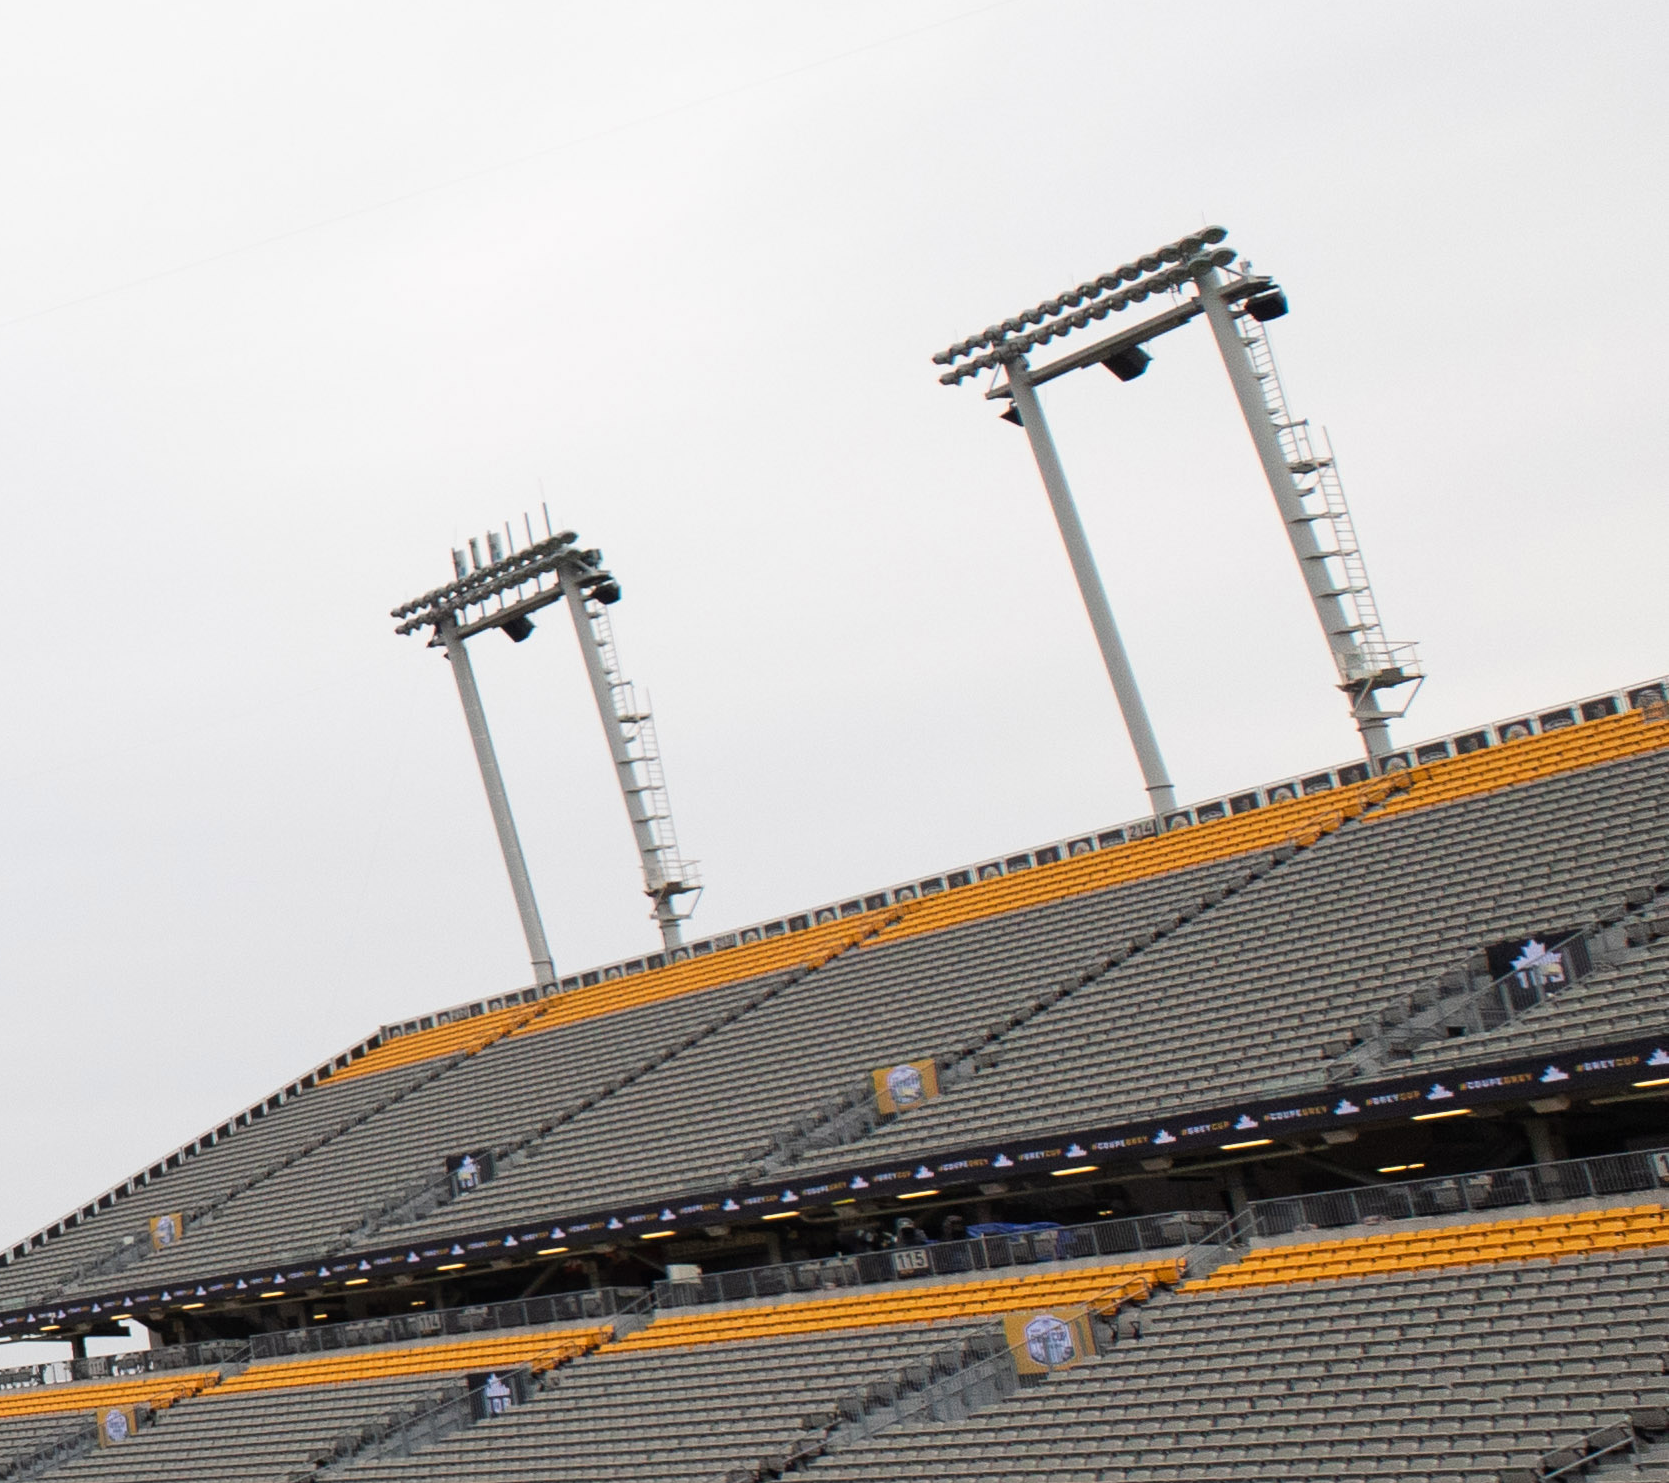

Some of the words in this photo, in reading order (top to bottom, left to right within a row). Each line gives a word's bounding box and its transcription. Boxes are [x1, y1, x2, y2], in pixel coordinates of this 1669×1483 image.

[1575, 1056, 1640, 1073] #GREYCUP
[1457, 1073, 1534, 1092] #COUPEGREY
[897, 1249, 925, 1269] 115
